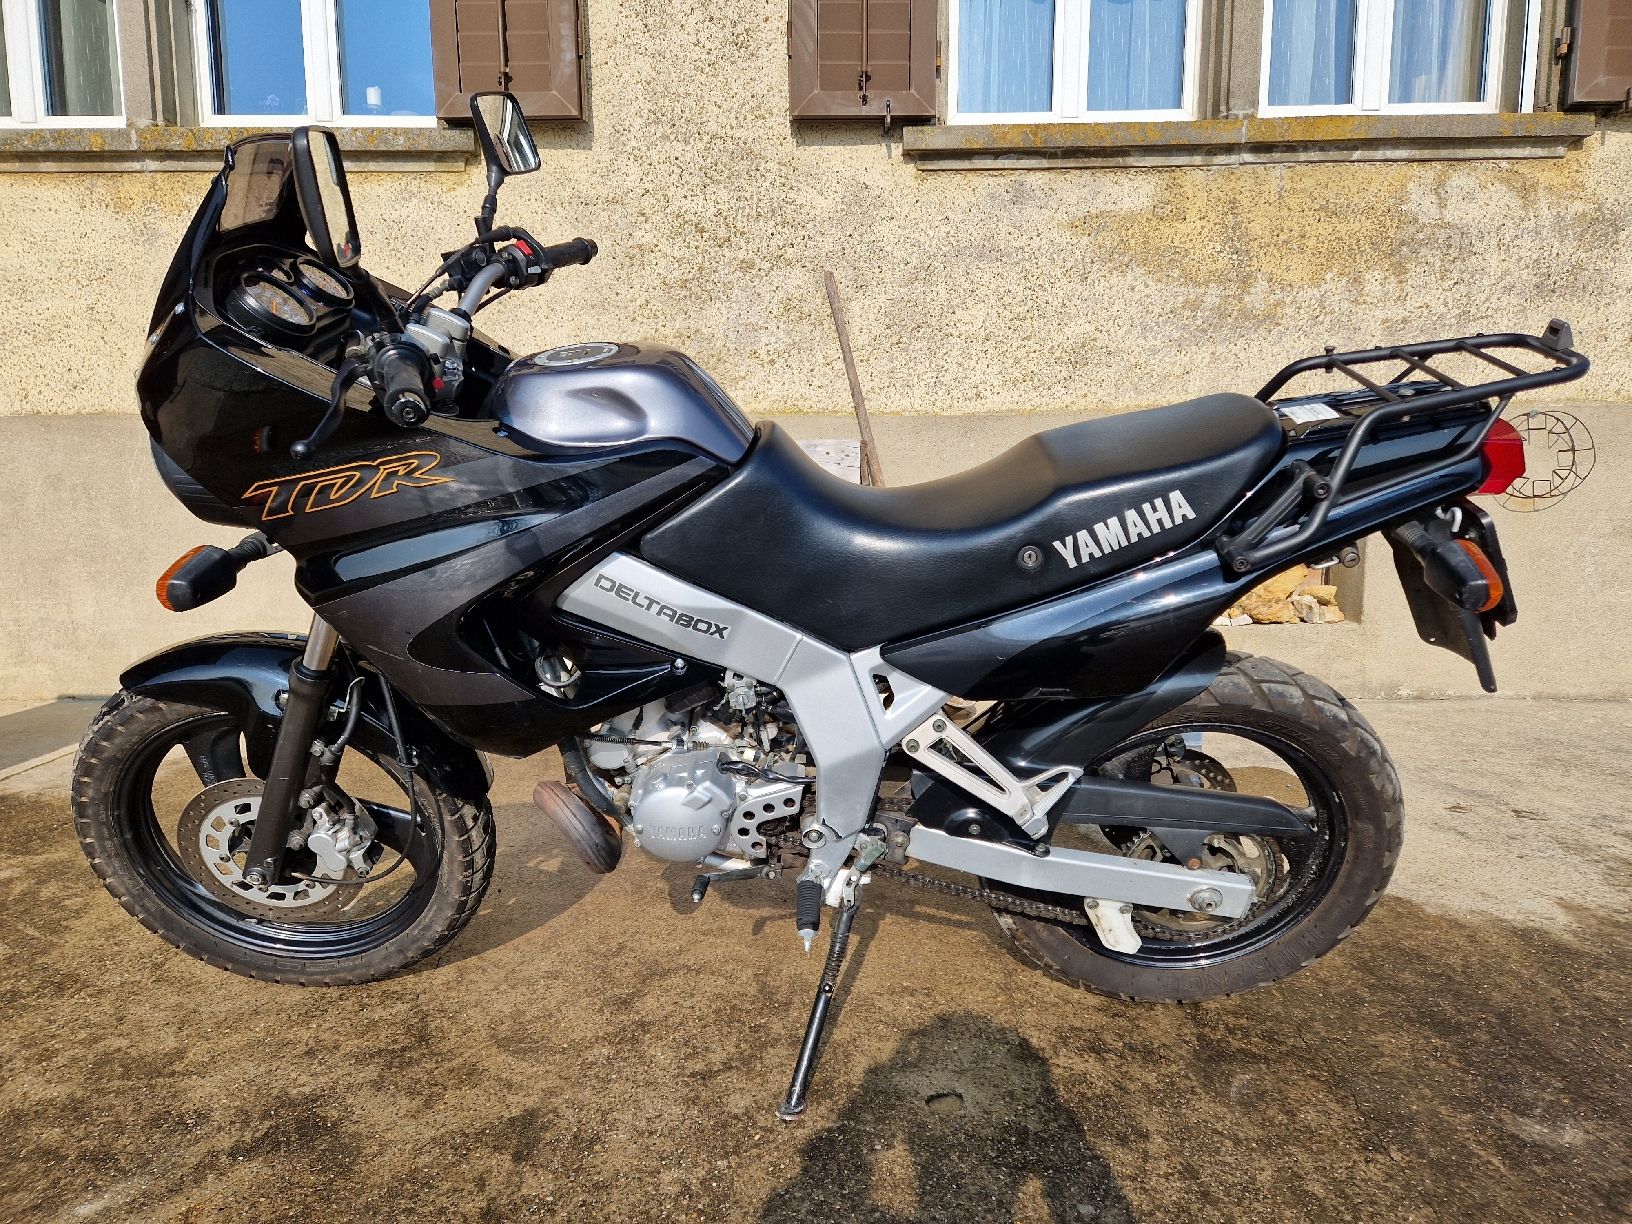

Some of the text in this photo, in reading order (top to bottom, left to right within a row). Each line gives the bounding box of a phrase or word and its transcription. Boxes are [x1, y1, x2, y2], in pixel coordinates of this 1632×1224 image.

[241, 451, 455, 521] TDR
[1052, 489, 1197, 569] YAMAHA
[593, 573, 730, 640] DELTABOX
